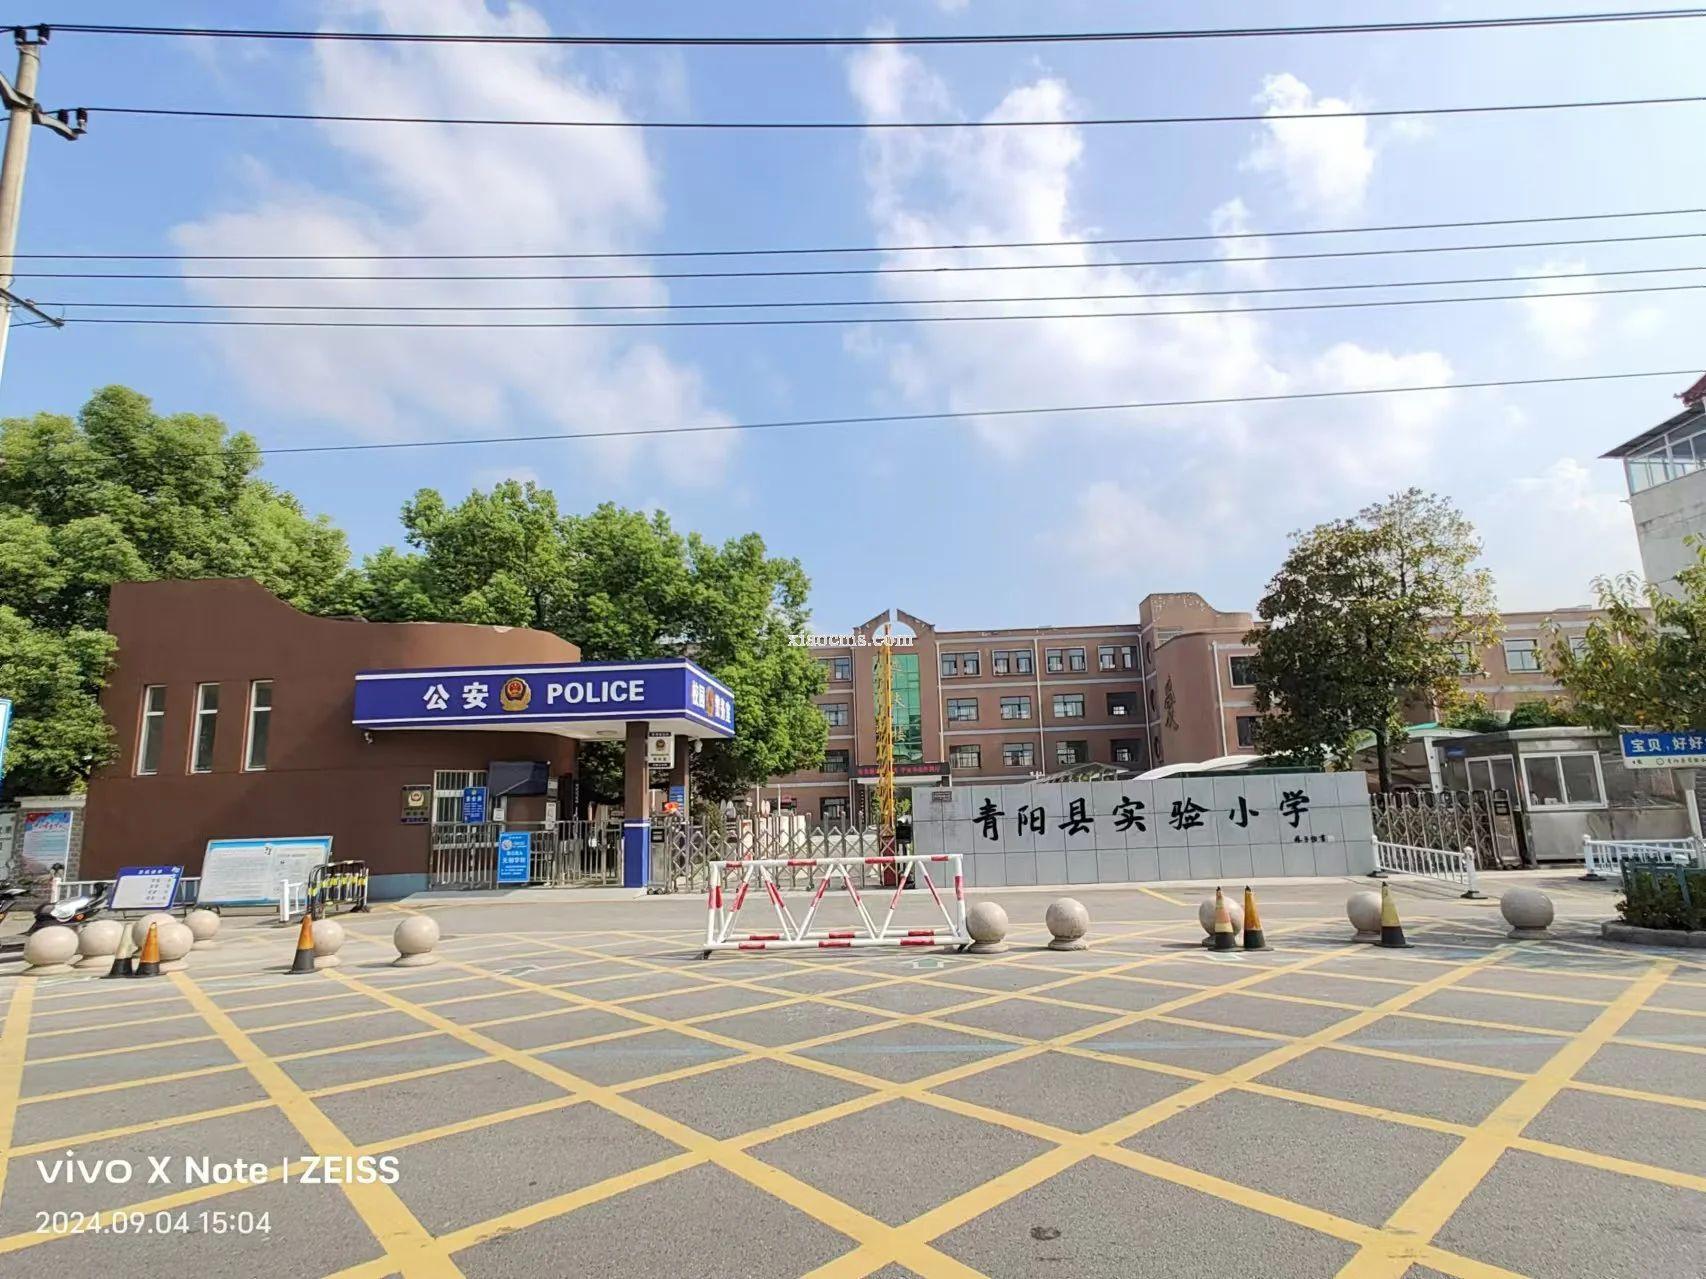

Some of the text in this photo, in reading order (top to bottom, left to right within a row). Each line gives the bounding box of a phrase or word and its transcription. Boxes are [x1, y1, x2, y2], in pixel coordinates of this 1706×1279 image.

[423, 681, 489, 711] 公安
[547, 680, 645, 704] POLICE
[1631, 735, 1706, 753] 宝贝，好好
[972, 789, 1311, 842] 青阳县实验小学
